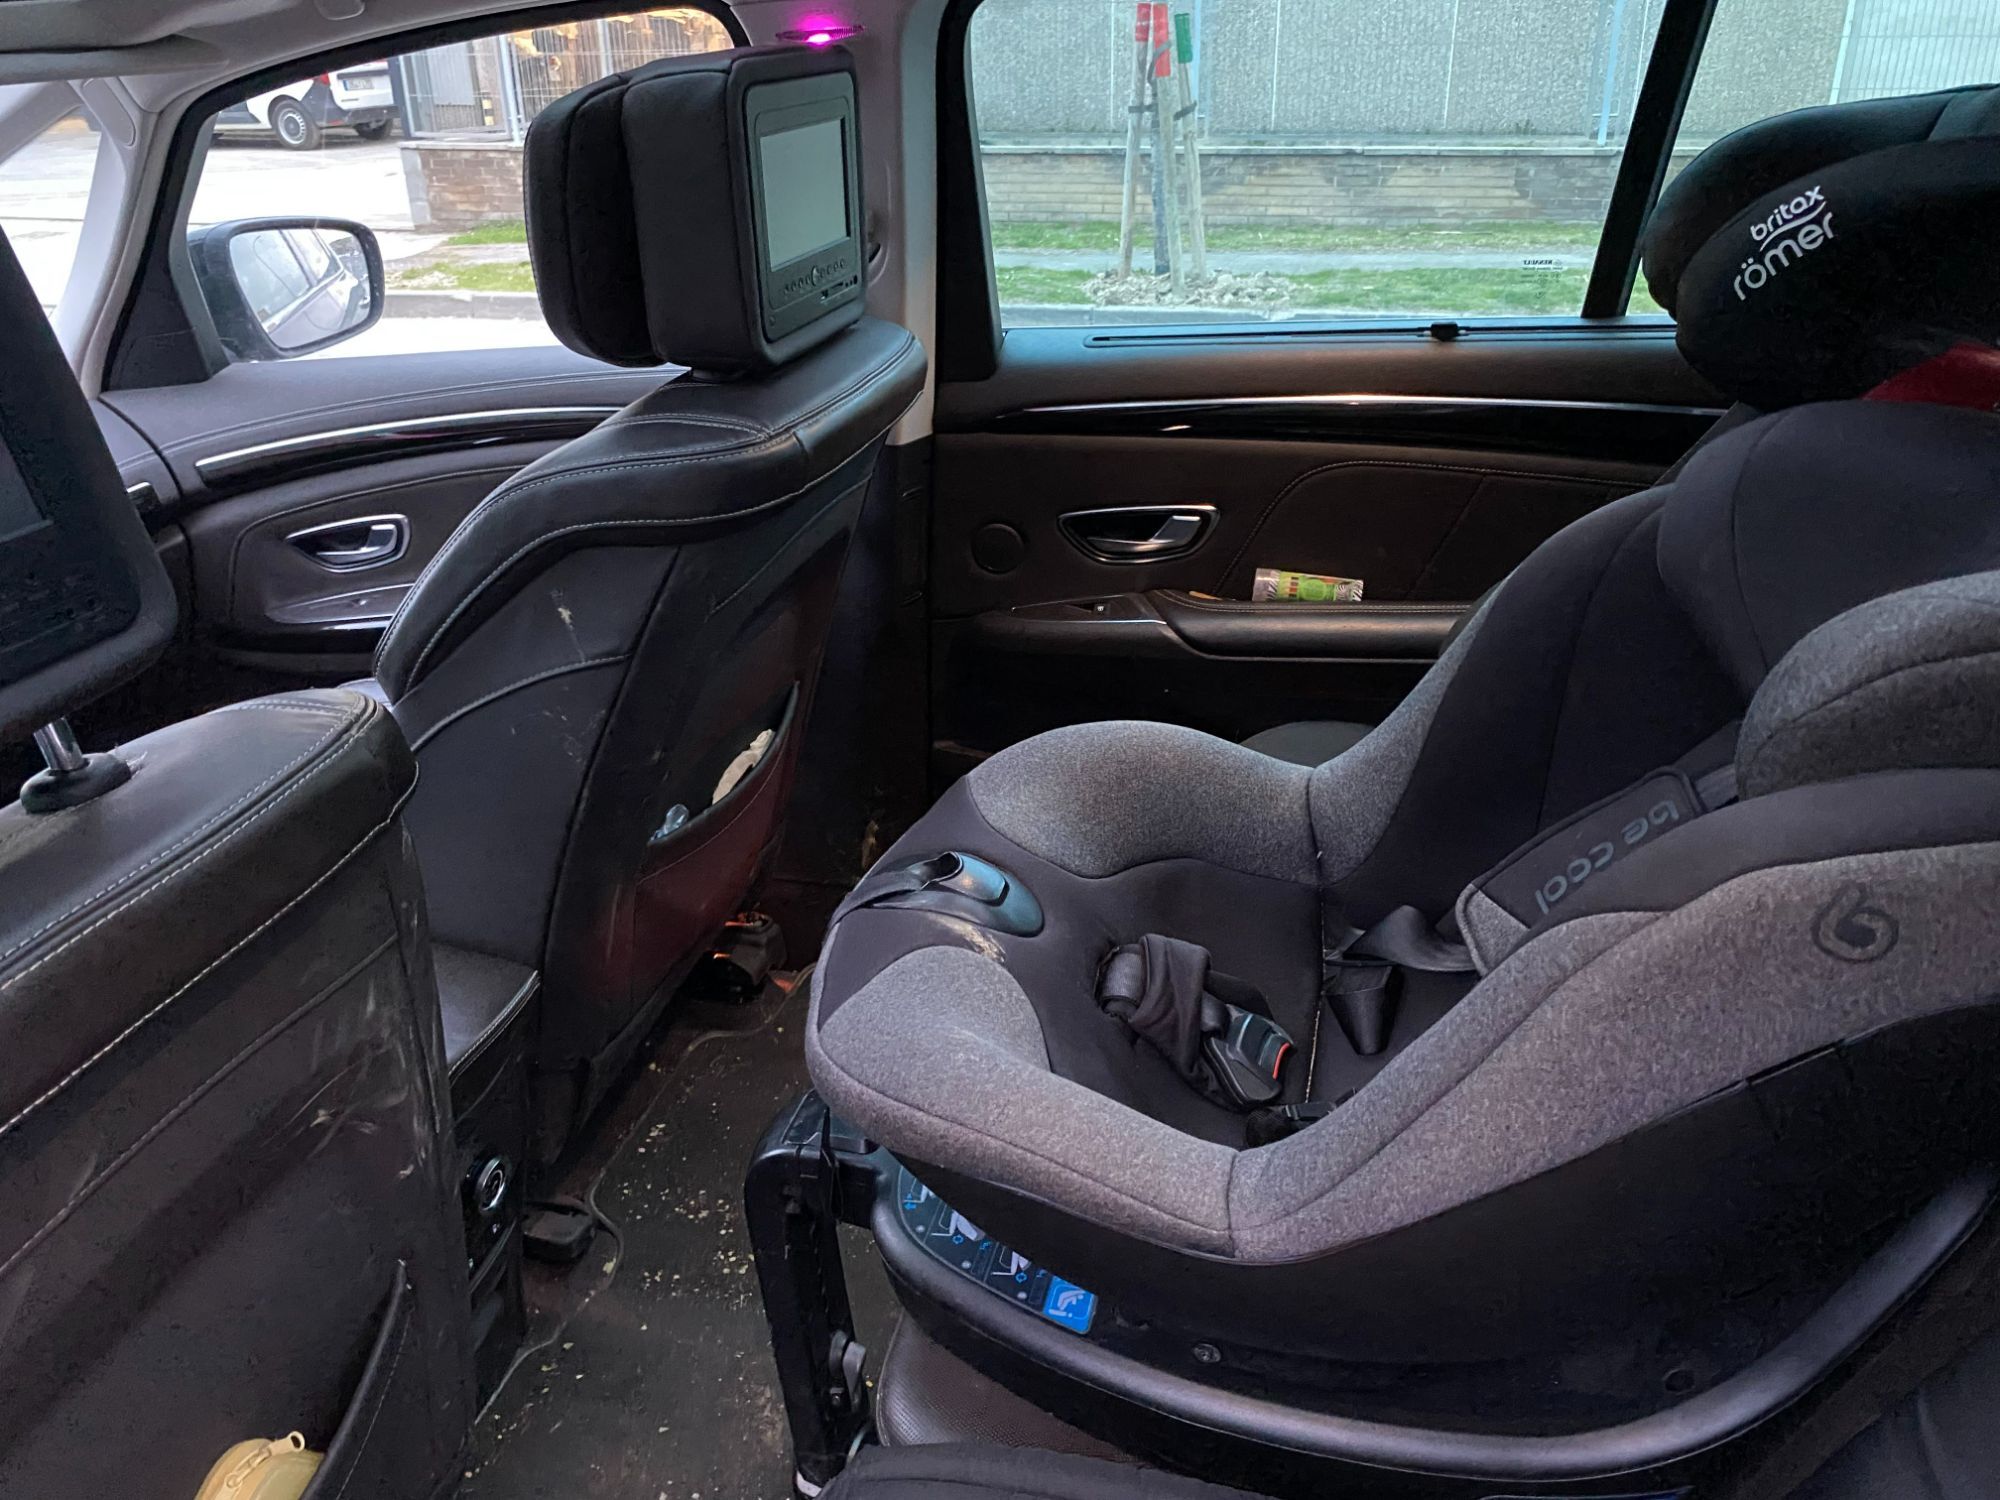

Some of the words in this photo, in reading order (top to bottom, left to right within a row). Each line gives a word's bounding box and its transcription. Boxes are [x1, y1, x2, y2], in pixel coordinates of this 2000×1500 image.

[1751, 185, 1825, 241] britax
[1733, 211, 1834, 301] römer
[1621, 800, 1680, 845] be
[1535, 841, 1614, 914] cool
